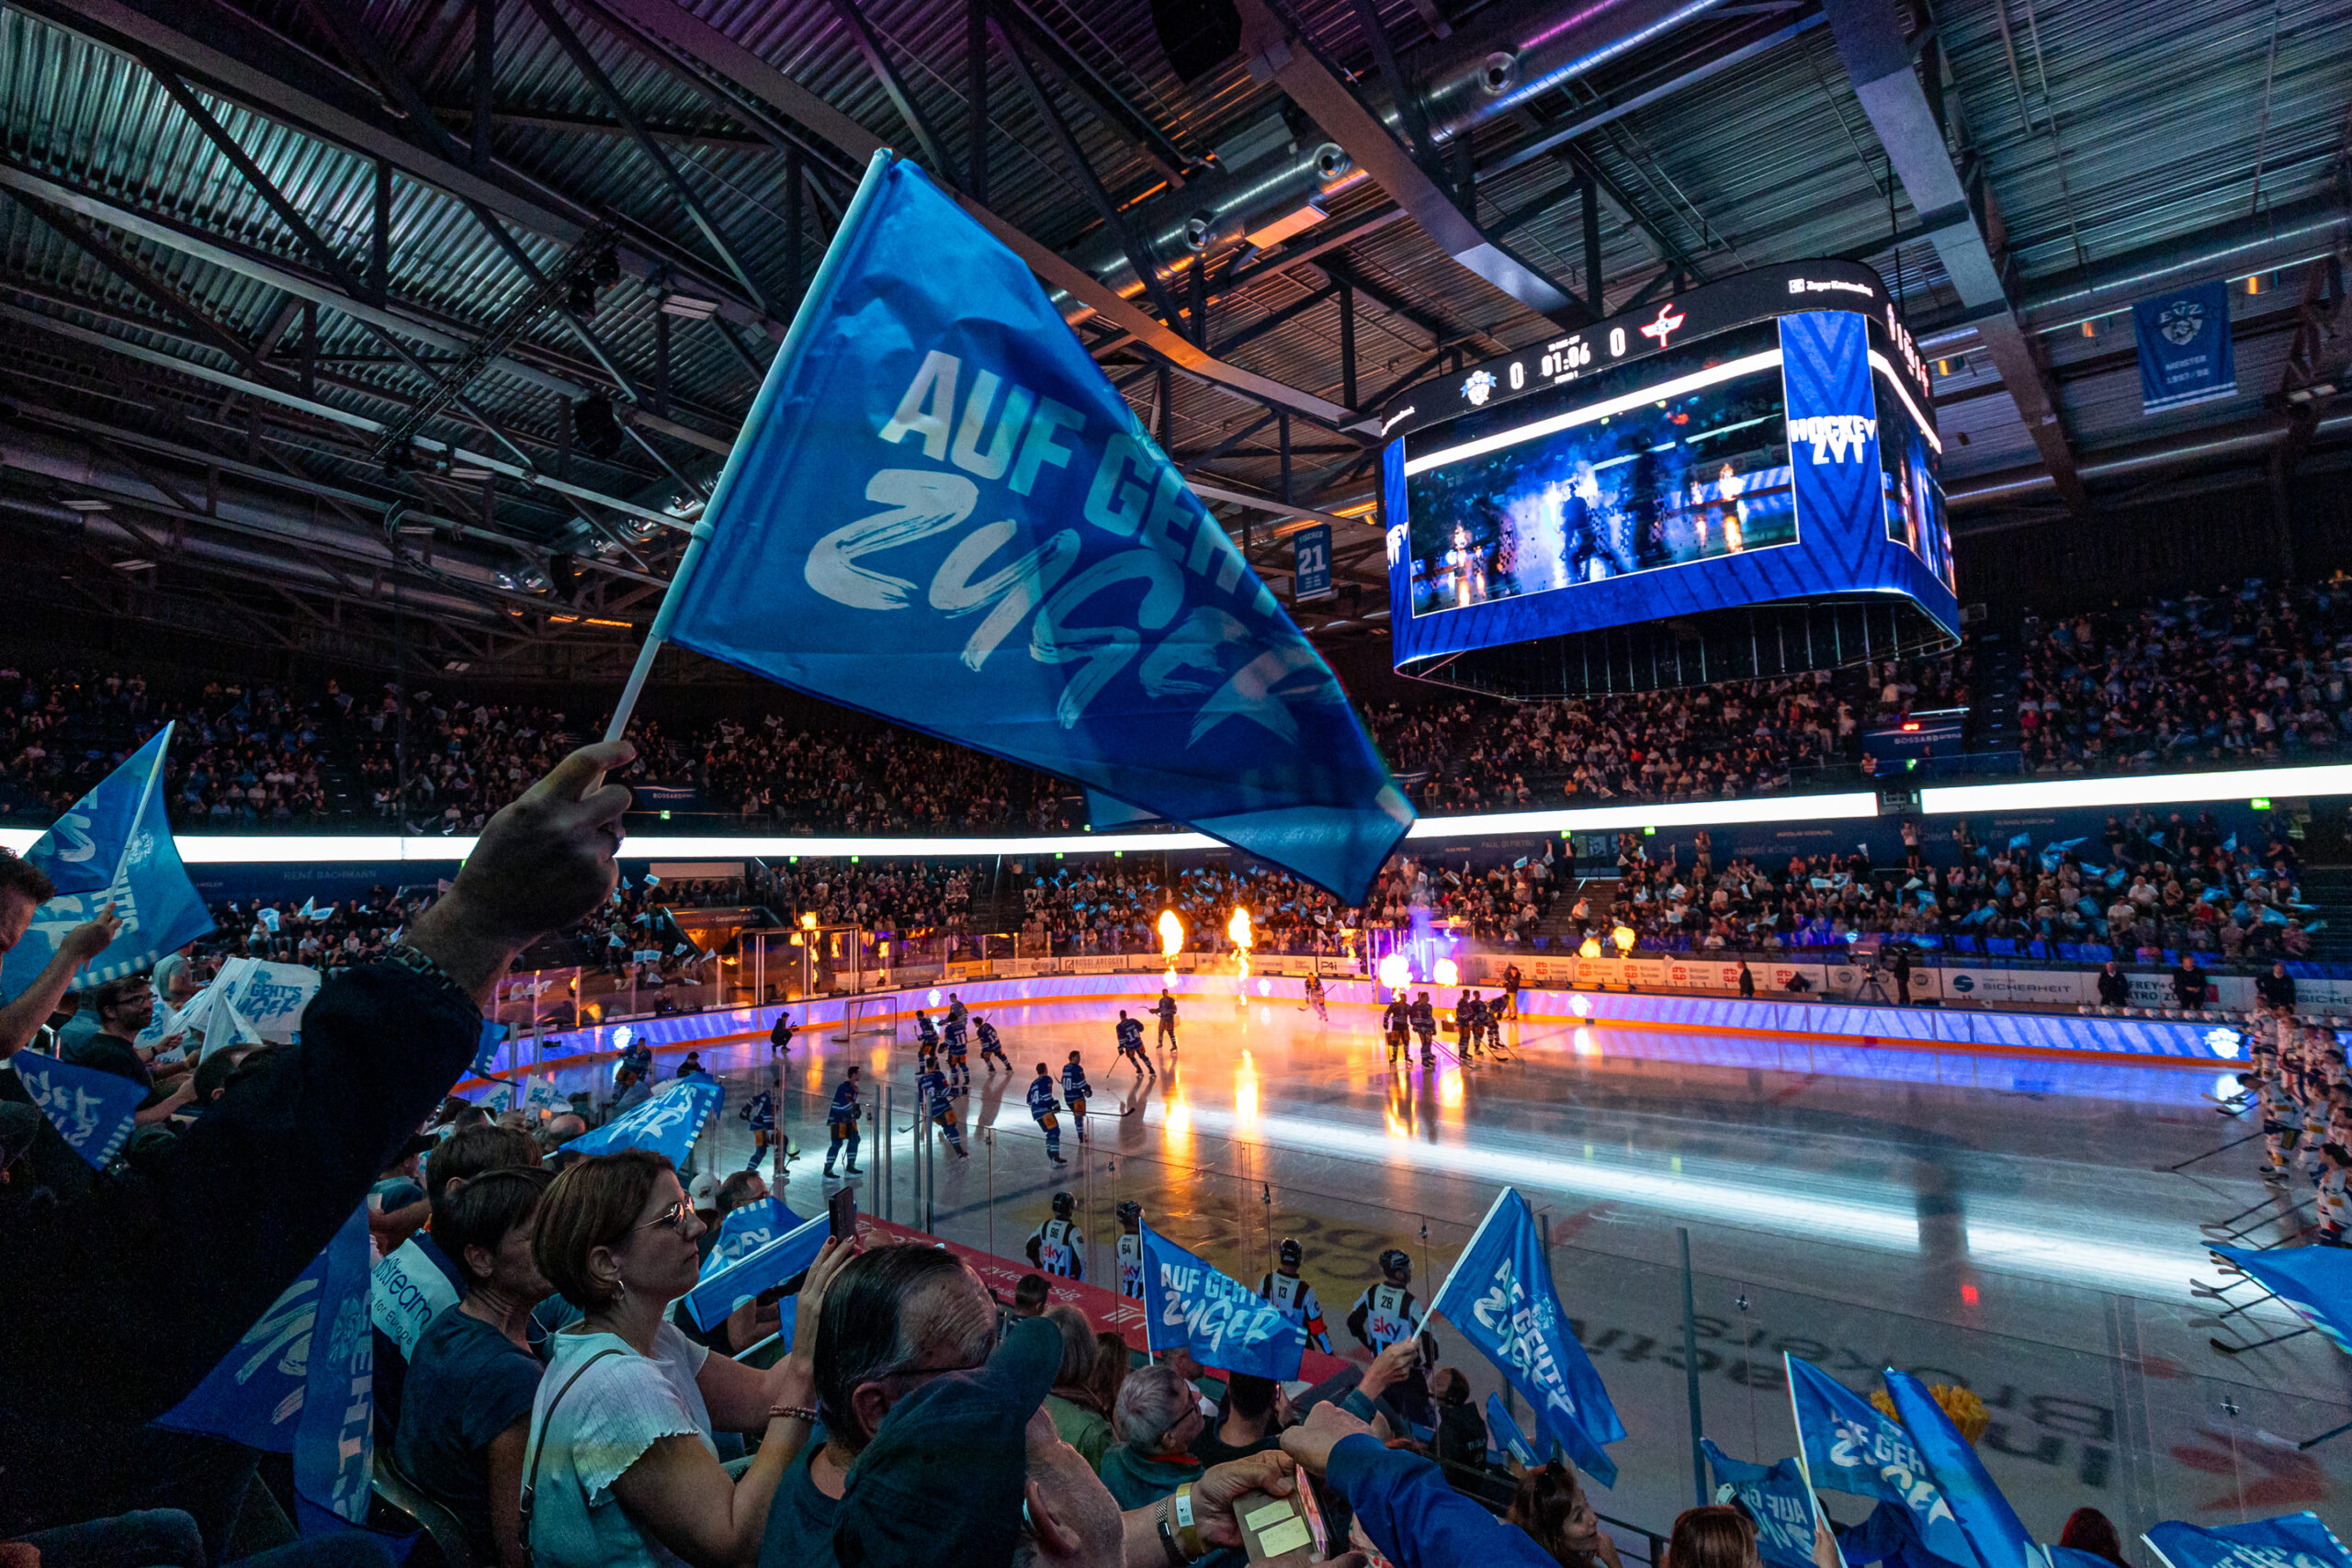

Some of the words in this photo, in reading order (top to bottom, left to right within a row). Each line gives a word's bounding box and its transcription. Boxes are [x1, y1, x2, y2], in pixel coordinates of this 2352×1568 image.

[2160, 304, 2202, 323] EVZ
[1541, 343, 1590, 377] 01:06
[878, 350, 1086, 497] AUF
[1789, 414, 1876, 445] HOCKEY
[1298, 545, 1326, 576] 21
[250, 984, 303, 998] GEHT'S
[1982, 983, 2072, 993] SICHERHEIT
[1044, 1243, 1066, 1264] sky
[1122, 1244, 1132, 1256] 64
[1161, 1262, 1199, 1290] AUF
[1278, 1286, 1287, 1300] 13
[1380, 1294, 1394, 1310] 28
[385, 1309, 413, 1346] Europe
[1373, 1315, 1402, 1341] sky
